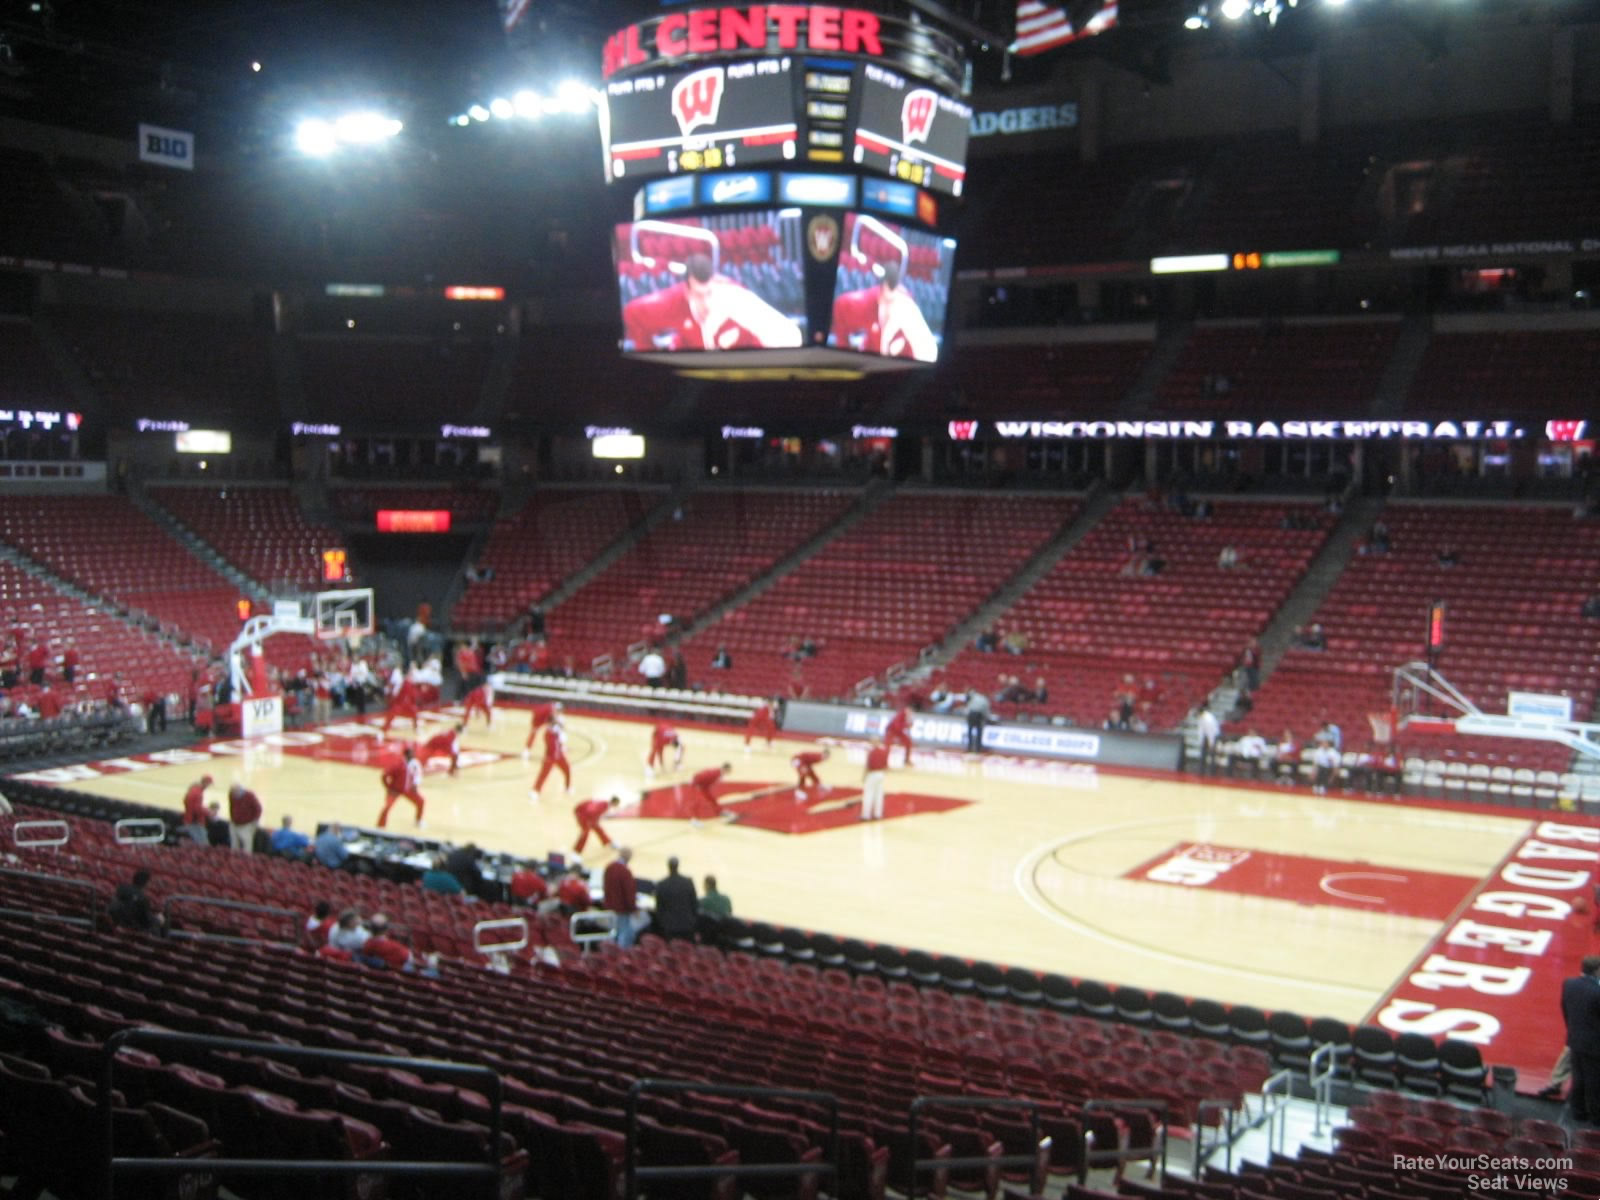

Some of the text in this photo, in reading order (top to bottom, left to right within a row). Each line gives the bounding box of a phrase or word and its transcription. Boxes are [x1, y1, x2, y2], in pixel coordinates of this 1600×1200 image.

[656, 6, 882, 56] CENTER
[675, 71, 721, 131] W
[995, 420, 1214, 438] WISCONSIN
[1377, 821, 1600, 1045] BADGERS
